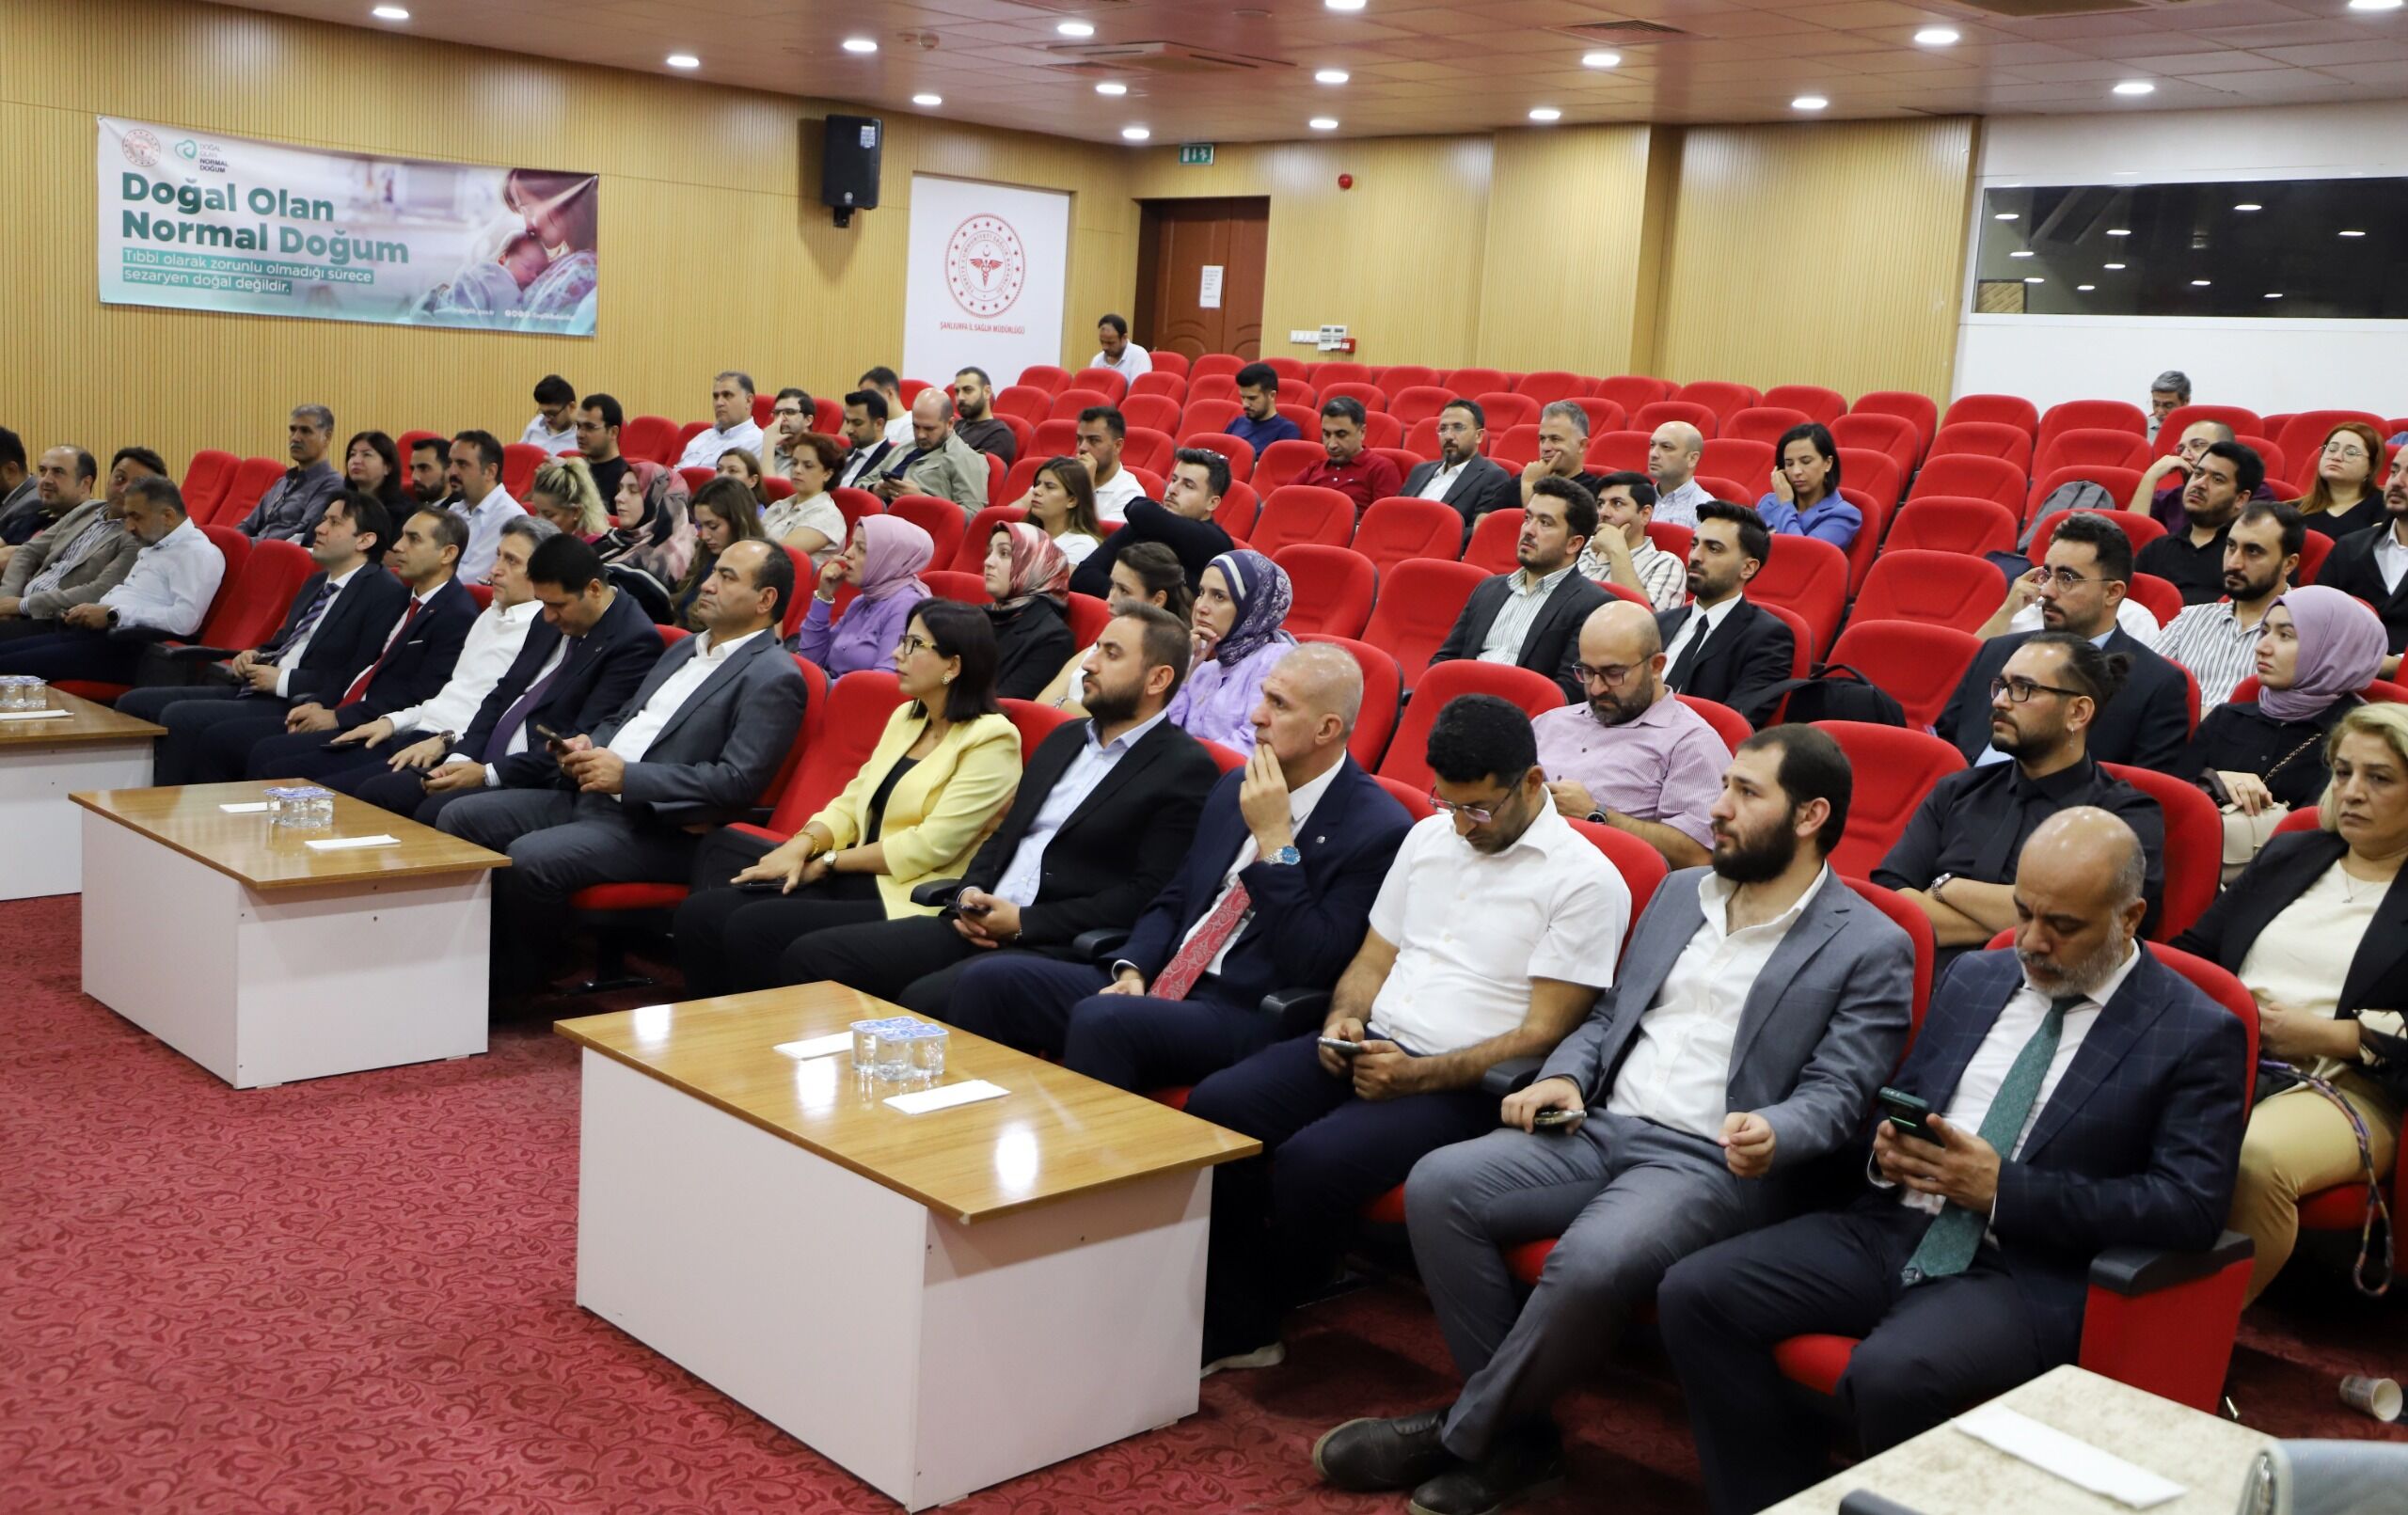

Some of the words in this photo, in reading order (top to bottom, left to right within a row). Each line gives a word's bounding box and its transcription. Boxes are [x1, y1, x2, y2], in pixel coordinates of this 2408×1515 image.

[199, 158, 230, 166] NORMAL
[199, 165, 226, 173] DOĞUM
[122, 172, 236, 214] Doğal
[247, 187, 334, 222] Olan
[122, 210, 268, 251] Normal
[279, 227, 409, 265] Doğum
[124, 248, 159, 263] Tıbbi
[164, 253, 207, 268] olarak
[210, 259, 262, 273] zorunlu
[266, 263, 325, 280] olmadığı
[327, 269, 372, 282] sürece
[124, 269, 189, 285] sezaryen
[193, 275, 231, 289] doğal
[235, 276, 290, 292] değildir.
[940, 322, 968, 331] ŞANLIURFA
[974, 323, 992, 332] SAĞLIK
[992, 324, 1025, 335] MÜDÜRLÜĞÜ
